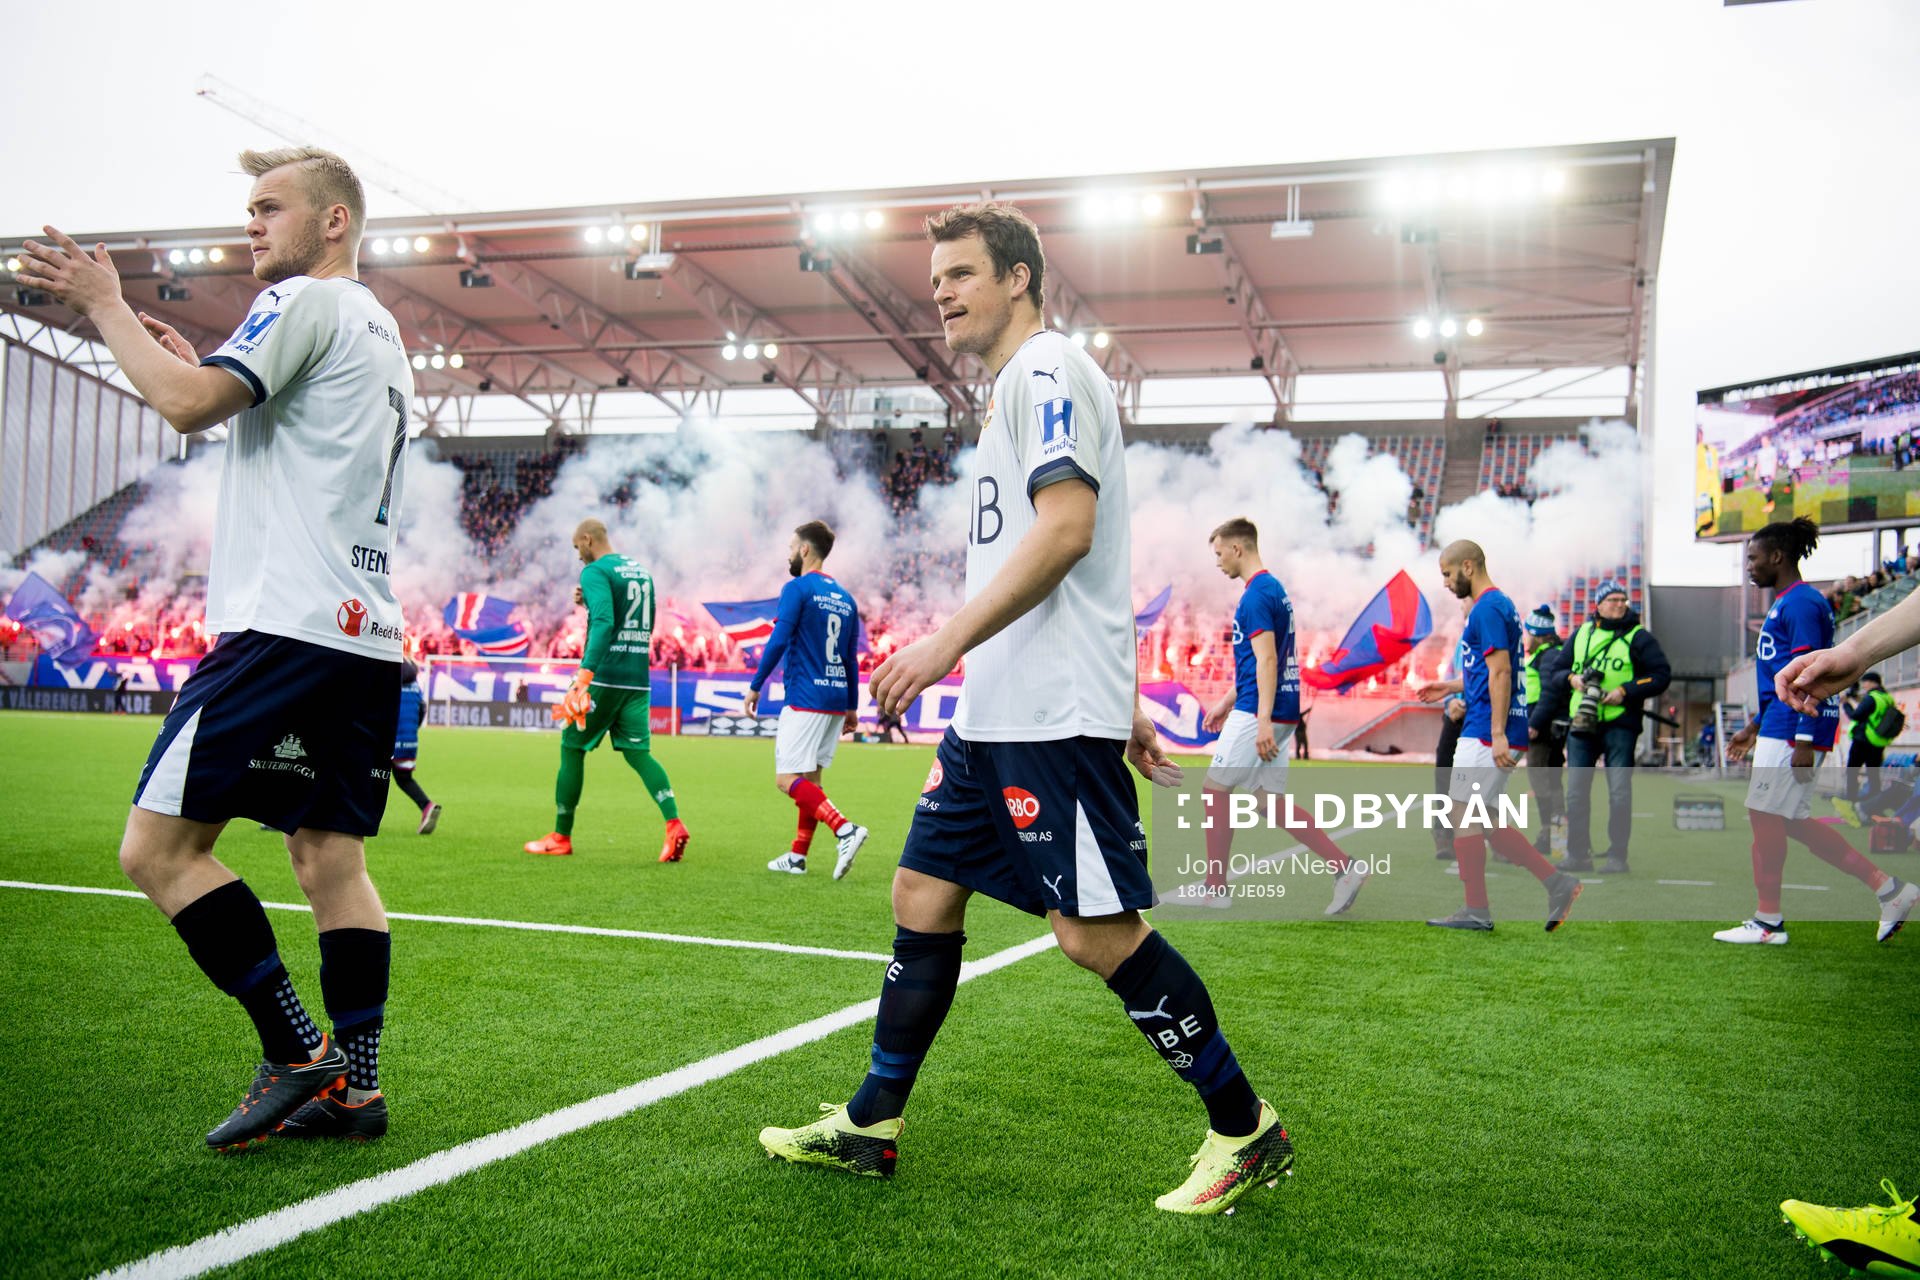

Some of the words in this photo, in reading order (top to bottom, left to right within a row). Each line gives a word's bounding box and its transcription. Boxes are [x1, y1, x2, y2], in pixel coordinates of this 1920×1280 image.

[624, 580, 650, 630] 21
[371, 621, 392, 639] Redd
[826, 613, 842, 664] 8
[105, 692, 152, 714] MLDE
[509, 706, 556, 728] MOLD
[1039, 831, 1052, 841] AS
